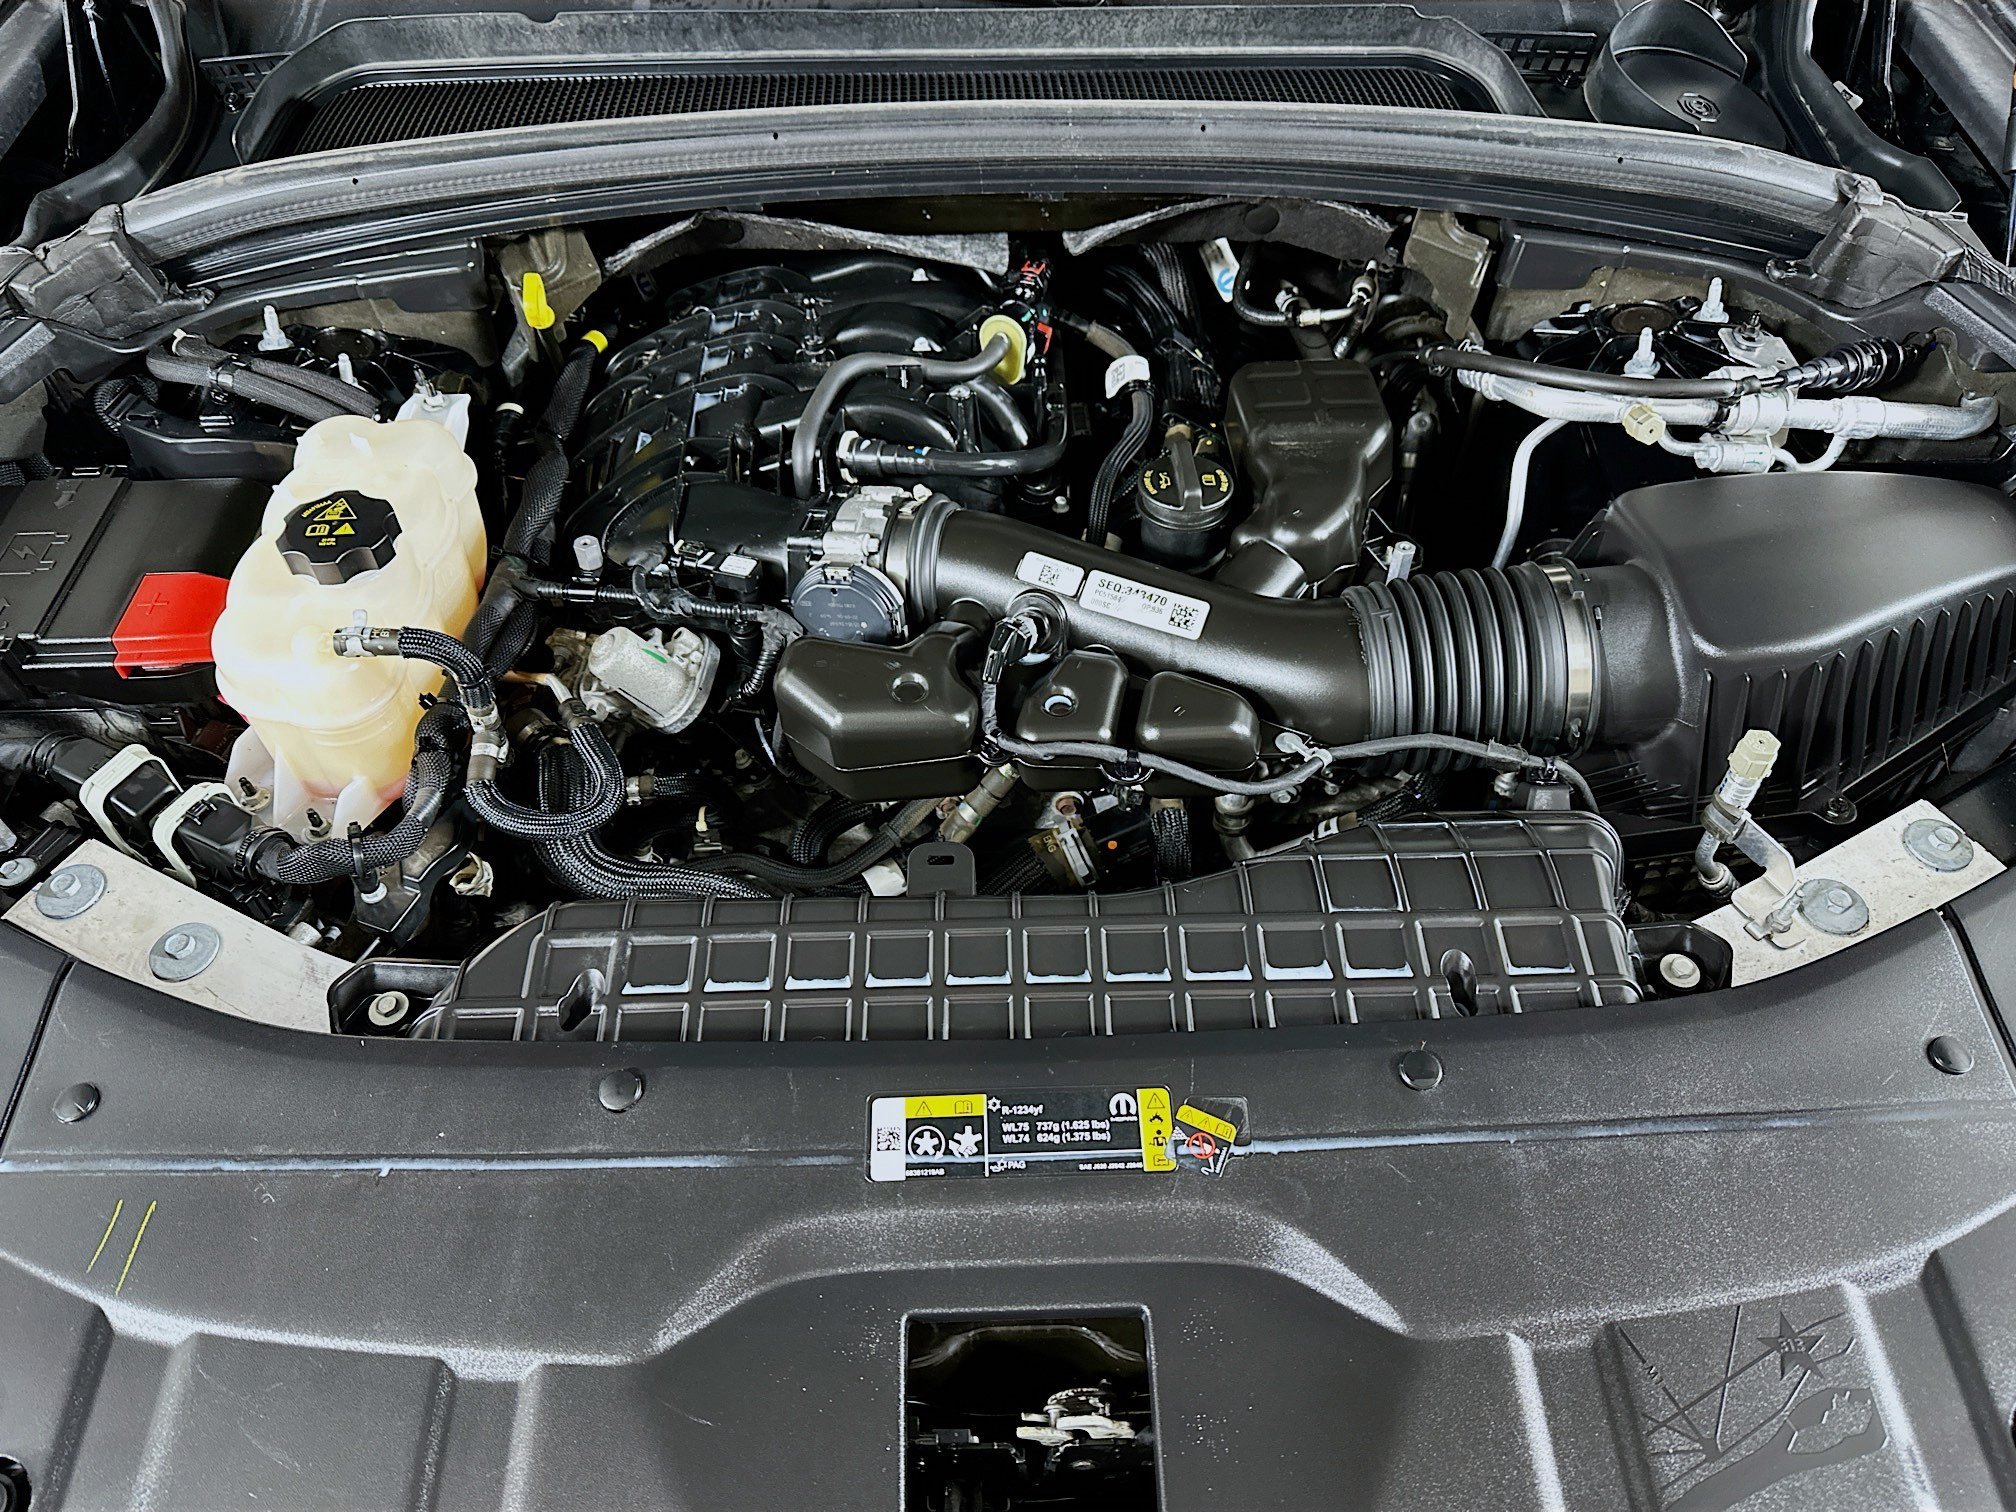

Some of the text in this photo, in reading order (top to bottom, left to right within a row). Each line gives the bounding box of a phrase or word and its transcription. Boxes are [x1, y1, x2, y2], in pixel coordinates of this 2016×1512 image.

[1001, 1104, 1044, 1116] R-1234yf
[1002, 1122, 1030, 1132] WL75
[1036, 1121, 1060, 1132] 737g
[1091, 1119, 1110, 1131] lbs)
[1002, 1131, 1111, 1144] WL74 624g (1.375 lbs)
[1007, 1160, 1027, 1170] PAG
[1777, 1337, 1806, 1353] 313
